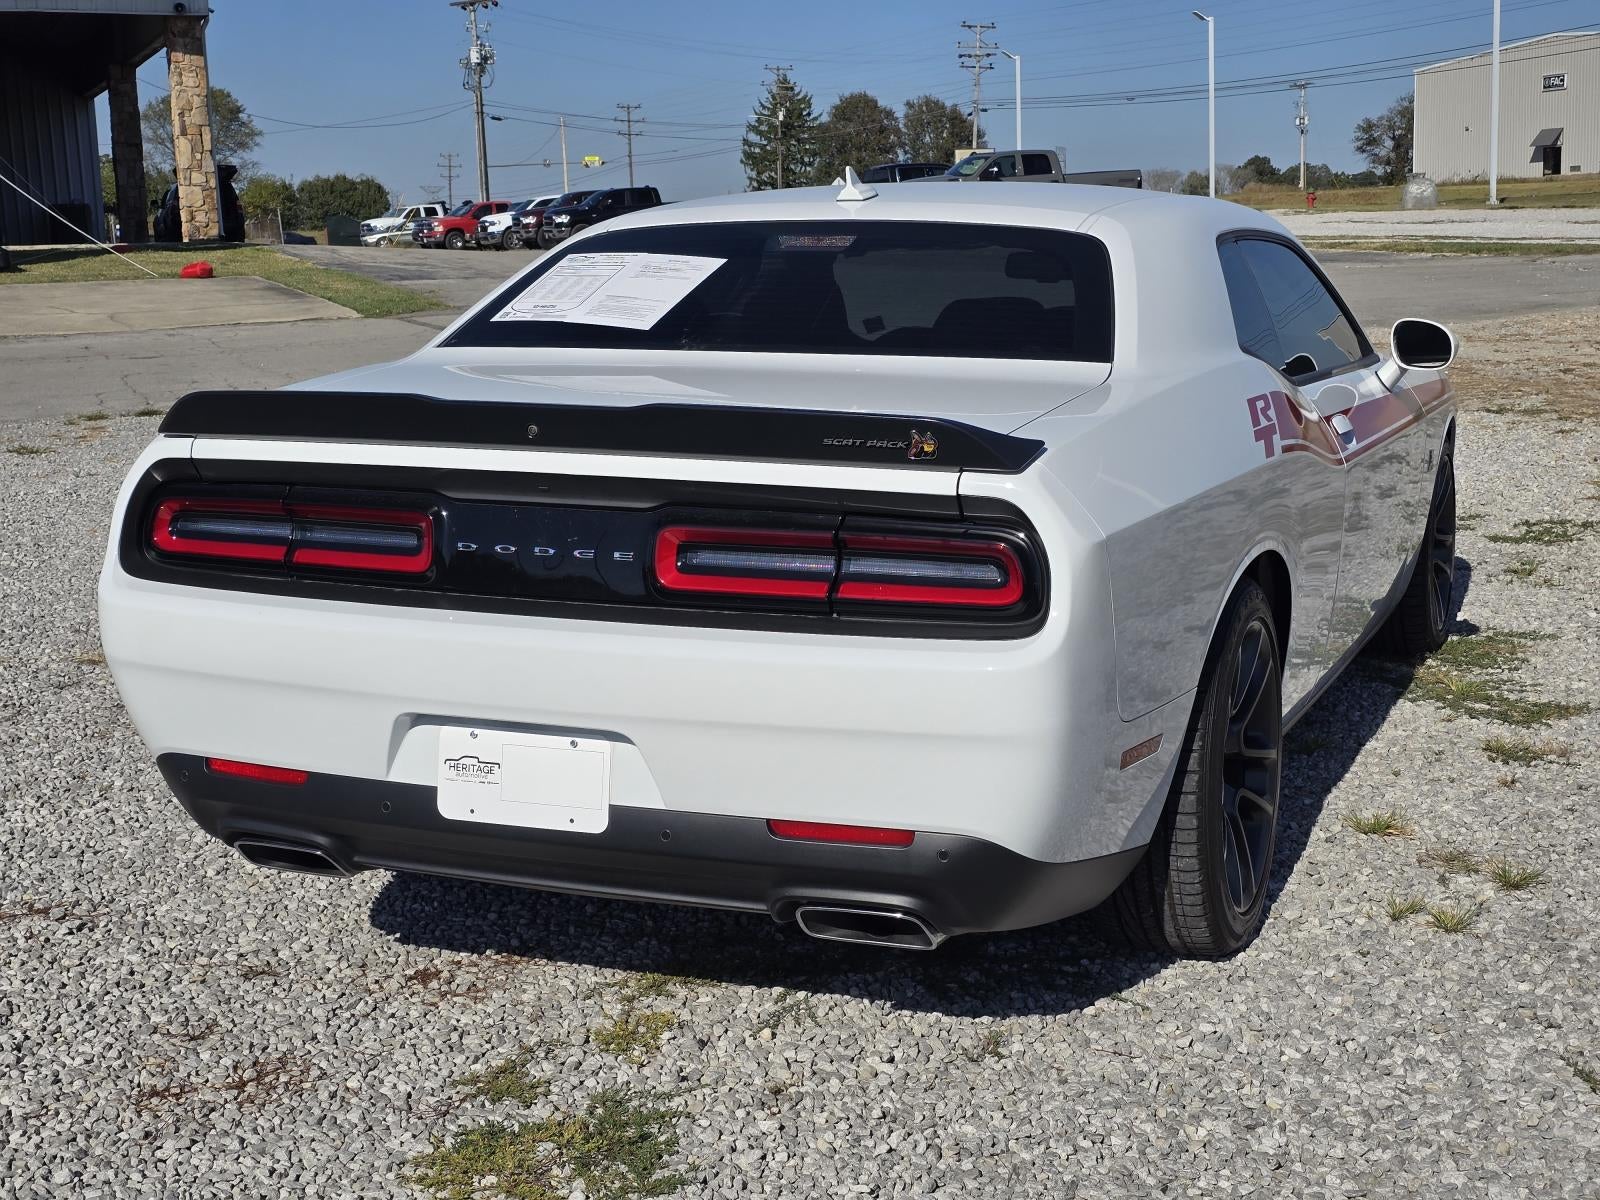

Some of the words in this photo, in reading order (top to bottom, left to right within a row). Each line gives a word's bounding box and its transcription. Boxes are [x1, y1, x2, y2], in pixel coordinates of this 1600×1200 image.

[822, 438, 865, 446] SCAT
[866, 440, 909, 449] PACK
[457, 542, 634, 561] DODGE
[448, 762, 496, 775] HERITAGE
